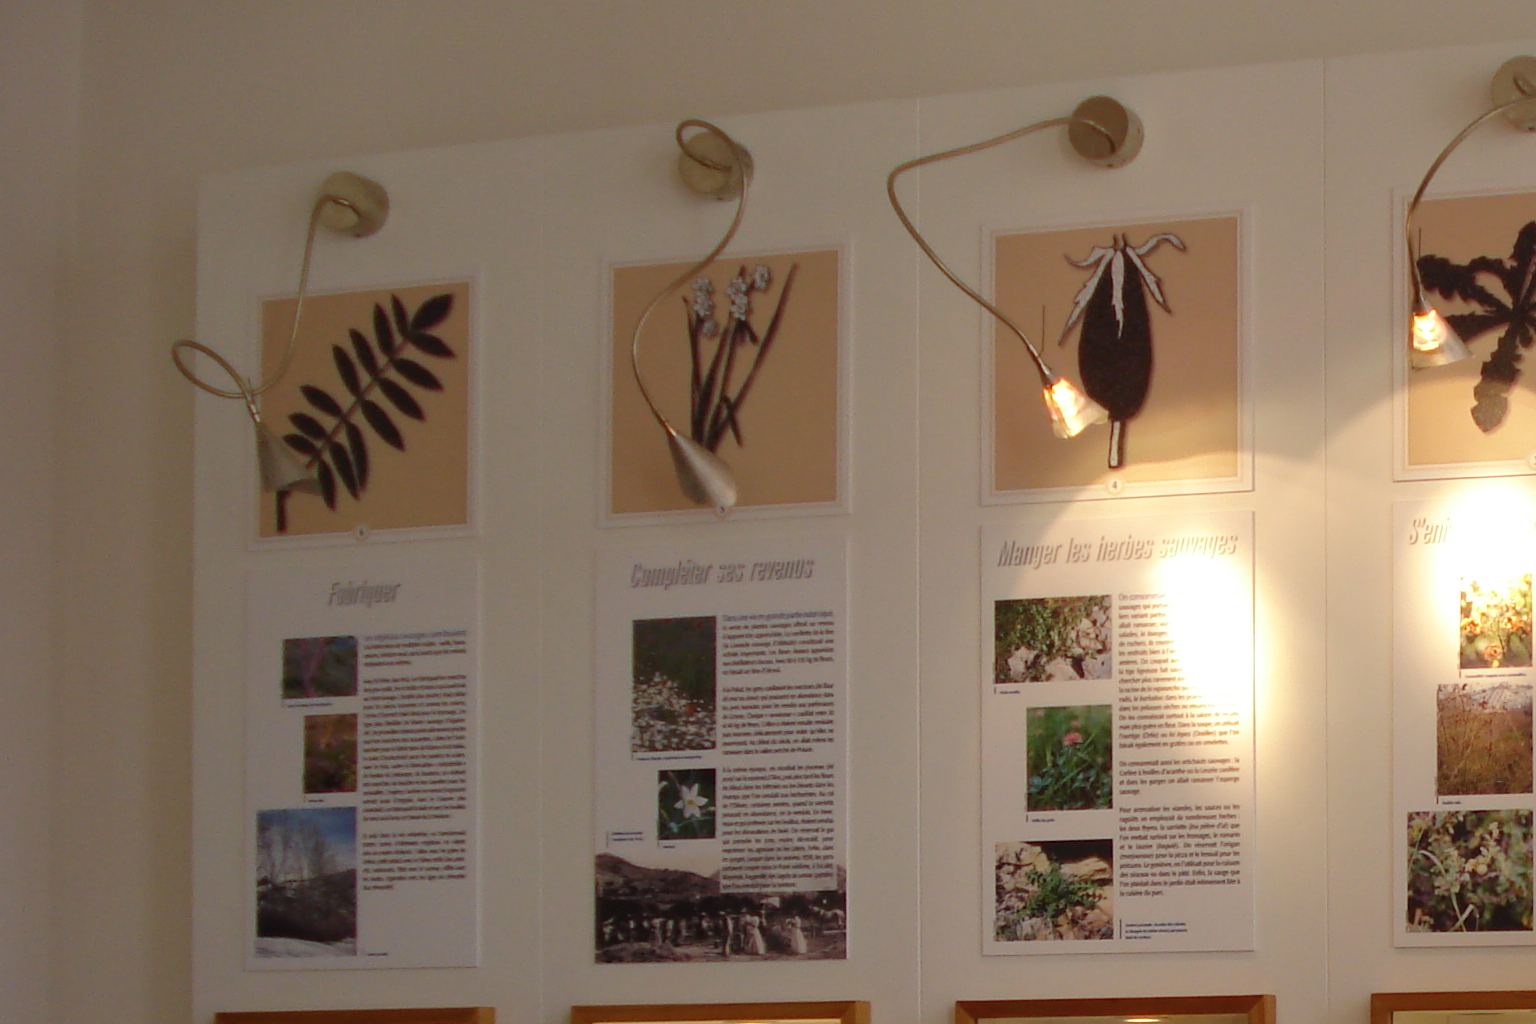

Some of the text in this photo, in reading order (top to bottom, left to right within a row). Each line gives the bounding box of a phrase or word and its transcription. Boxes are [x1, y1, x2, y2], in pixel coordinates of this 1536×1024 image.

[1112, 480, 1118, 490] 4
[996, 534, 1239, 570] Manger les herbes sauvages
[630, 559, 815, 590] Compléter ses revenus
